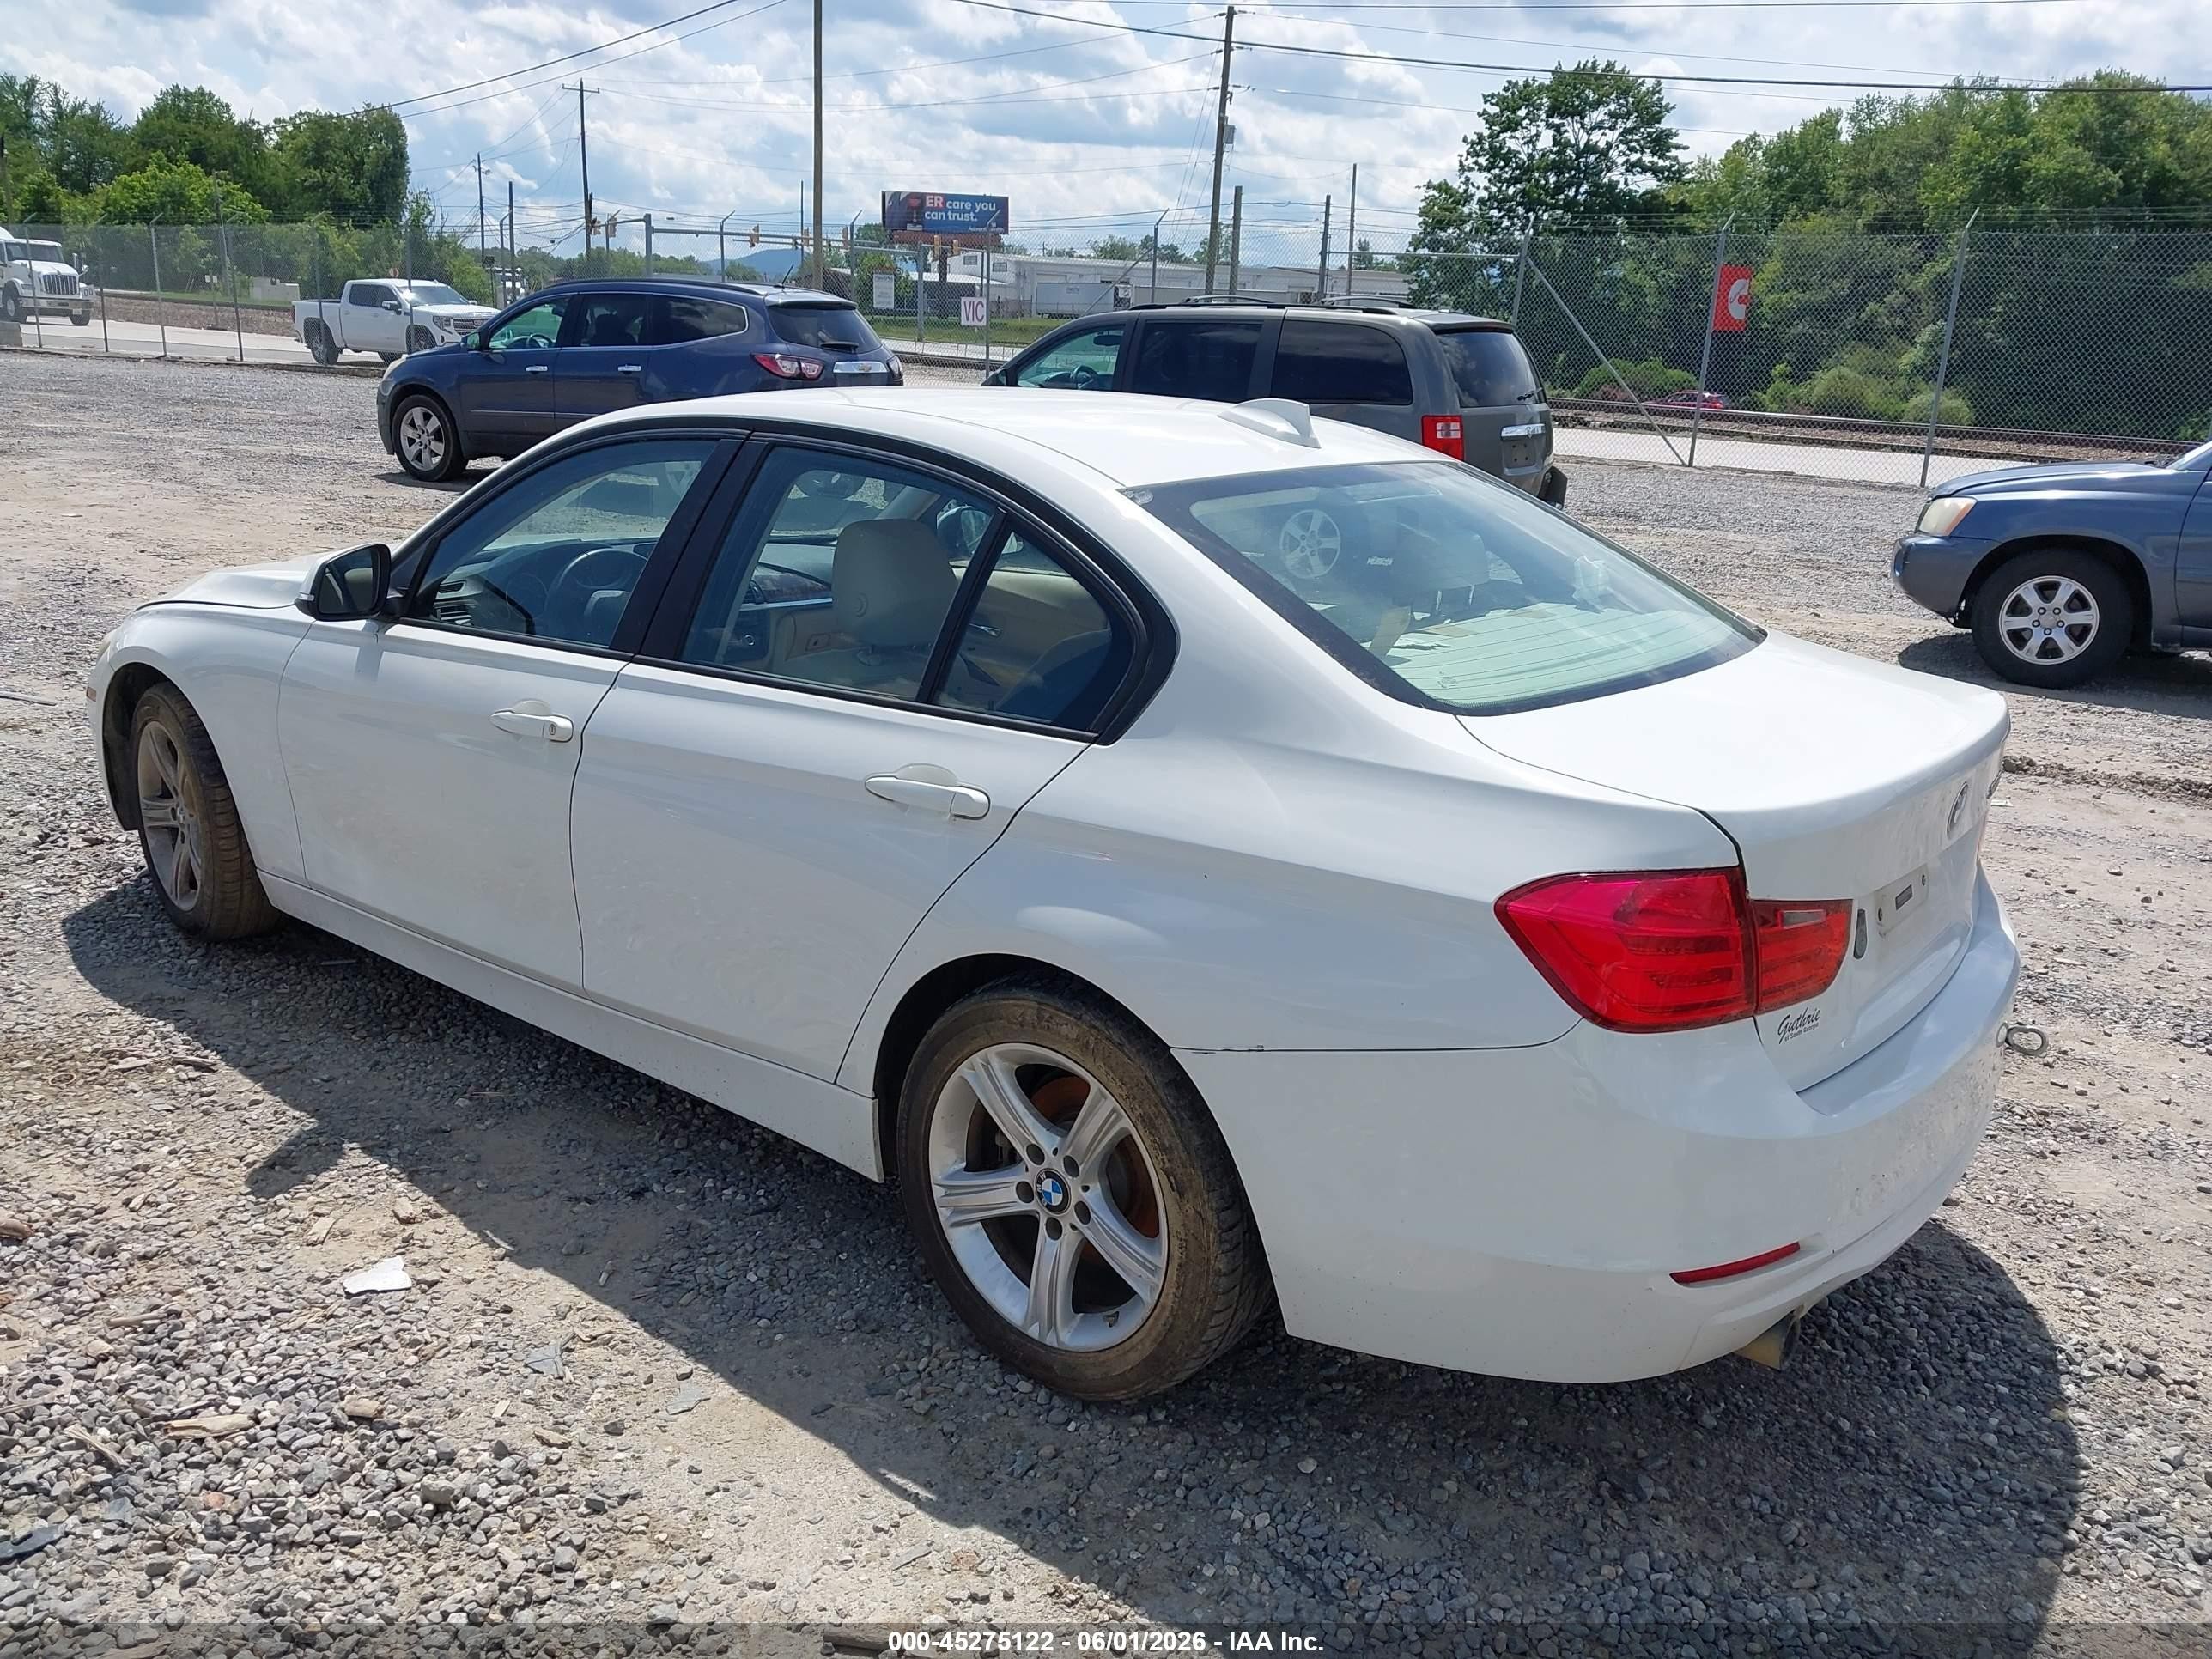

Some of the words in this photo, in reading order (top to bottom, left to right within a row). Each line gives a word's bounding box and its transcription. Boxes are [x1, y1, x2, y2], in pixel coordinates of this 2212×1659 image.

[926, 195, 944, 207] ER
[946, 200, 972, 210] care
[975, 202, 996, 213] you
[925, 210, 945, 220] can
[947, 210, 978, 222] trust.
[963, 301, 985, 322] VIC
[1778, 1007, 1820, 1044] Guthrie
